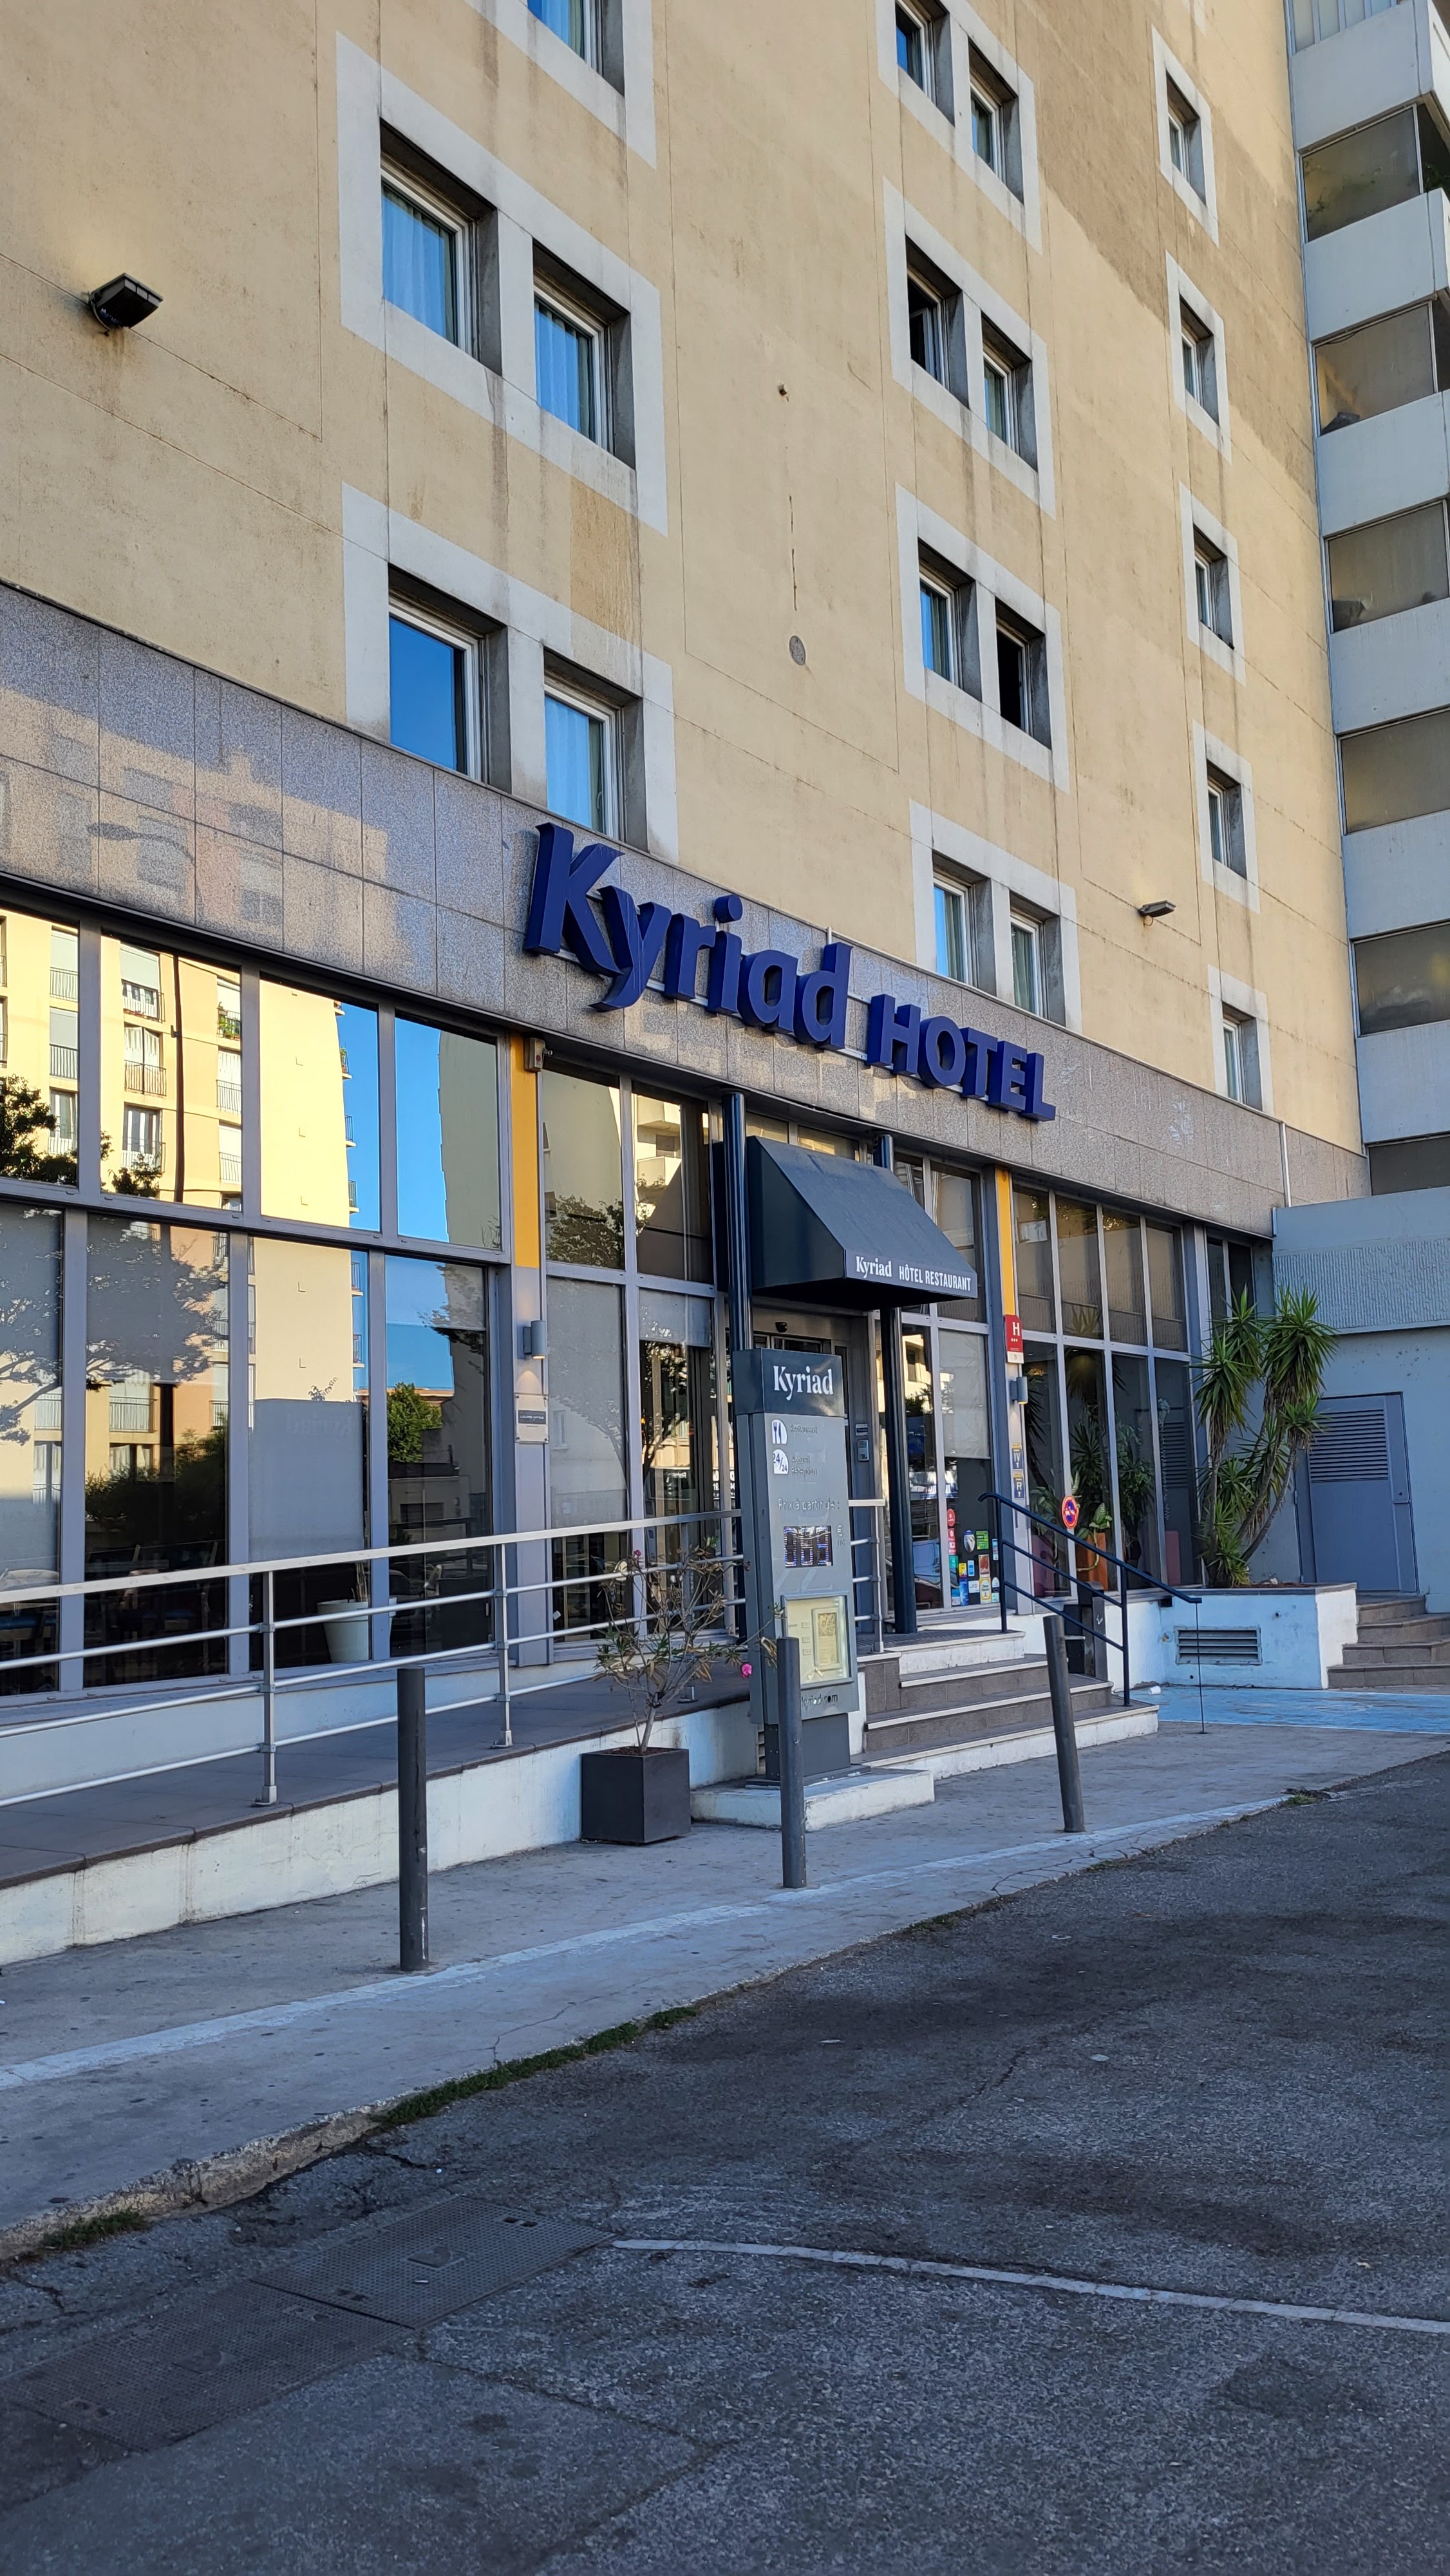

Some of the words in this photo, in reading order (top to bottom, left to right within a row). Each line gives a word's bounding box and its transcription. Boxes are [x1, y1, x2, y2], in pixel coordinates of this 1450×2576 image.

[524, 822, 853, 1051] Kyriad
[867, 993, 1056, 1121] HOTEL
[855, 1256, 892, 1278] Kyriad
[899, 1264, 923, 1284] HÔTEL
[925, 1270, 972, 1291] RESTAURANT
[1012, 1321, 1021, 1336] H
[773, 1365, 834, 1401] Kyriad
[778, 1498, 794, 1510] Prix
[796, 1499, 800, 1510] à
[802, 1498, 824, 1513] partir
[826, 1498, 835, 1510] de
